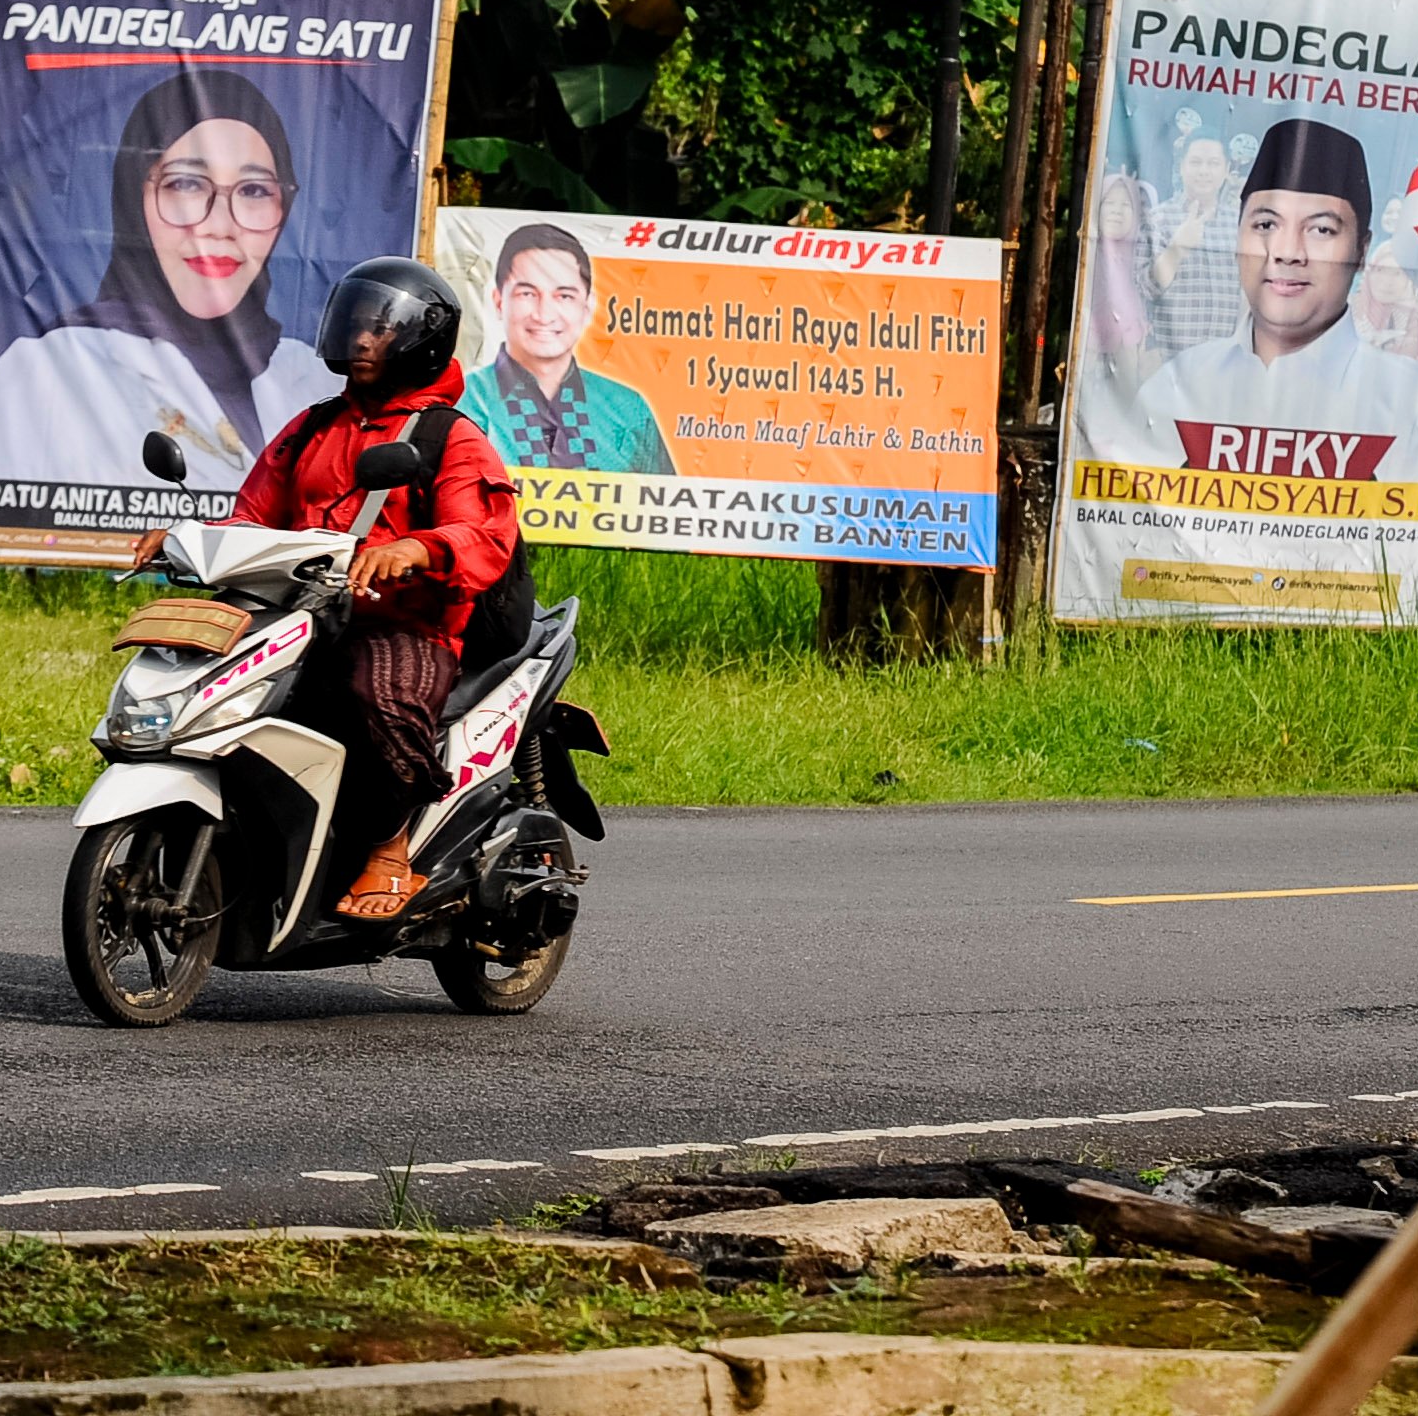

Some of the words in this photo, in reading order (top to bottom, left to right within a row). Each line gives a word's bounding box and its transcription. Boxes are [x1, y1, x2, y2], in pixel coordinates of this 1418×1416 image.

[2, 2, 289, 56] PANDEGLANG
[295, 15, 414, 61] SATU
[1128, 58, 1257, 98] RUMAH
[1267, 72, 1346, 106] KITA
[624, 221, 945, 269] #dulurdimyati
[607, 297, 714, 339] Selamat
[724, 302, 782, 344] Hari
[793, 307, 860, 353] Raya
[870, 310, 921, 351] Idul
[931, 315, 986, 354] Fitri
[687, 358, 697, 386] 1
[707, 361, 799, 395] Syawal
[809, 366, 864, 396] 1445
[874, 367, 905, 397] H.
[677, 416, 748, 442] Mohon
[755, 419, 813, 451] Maaf
[814, 422, 875, 449] Lahir
[883, 428, 902, 449] &
[911, 428, 984, 455] Bathin
[1207, 426, 1361, 479] RIFKY
[50, 486, 125, 514] ANITA
[639, 486, 969, 524] NATAKUSUMAH
[1080, 465, 1366, 519] HERMIANSYAH,
[53, 511, 98, 528] BAKAL
[99, 513, 145, 530] CALON
[592, 512, 799, 543] GUBERNUR
[813, 523, 969, 554] BANTEN
[1077, 507, 1127, 526] BAKAL
[1132, 511, 1186, 529] CALON
[1192, 516, 1254, 536] BUPATI
[1259, 522, 1369, 541] PANDEGLANG
